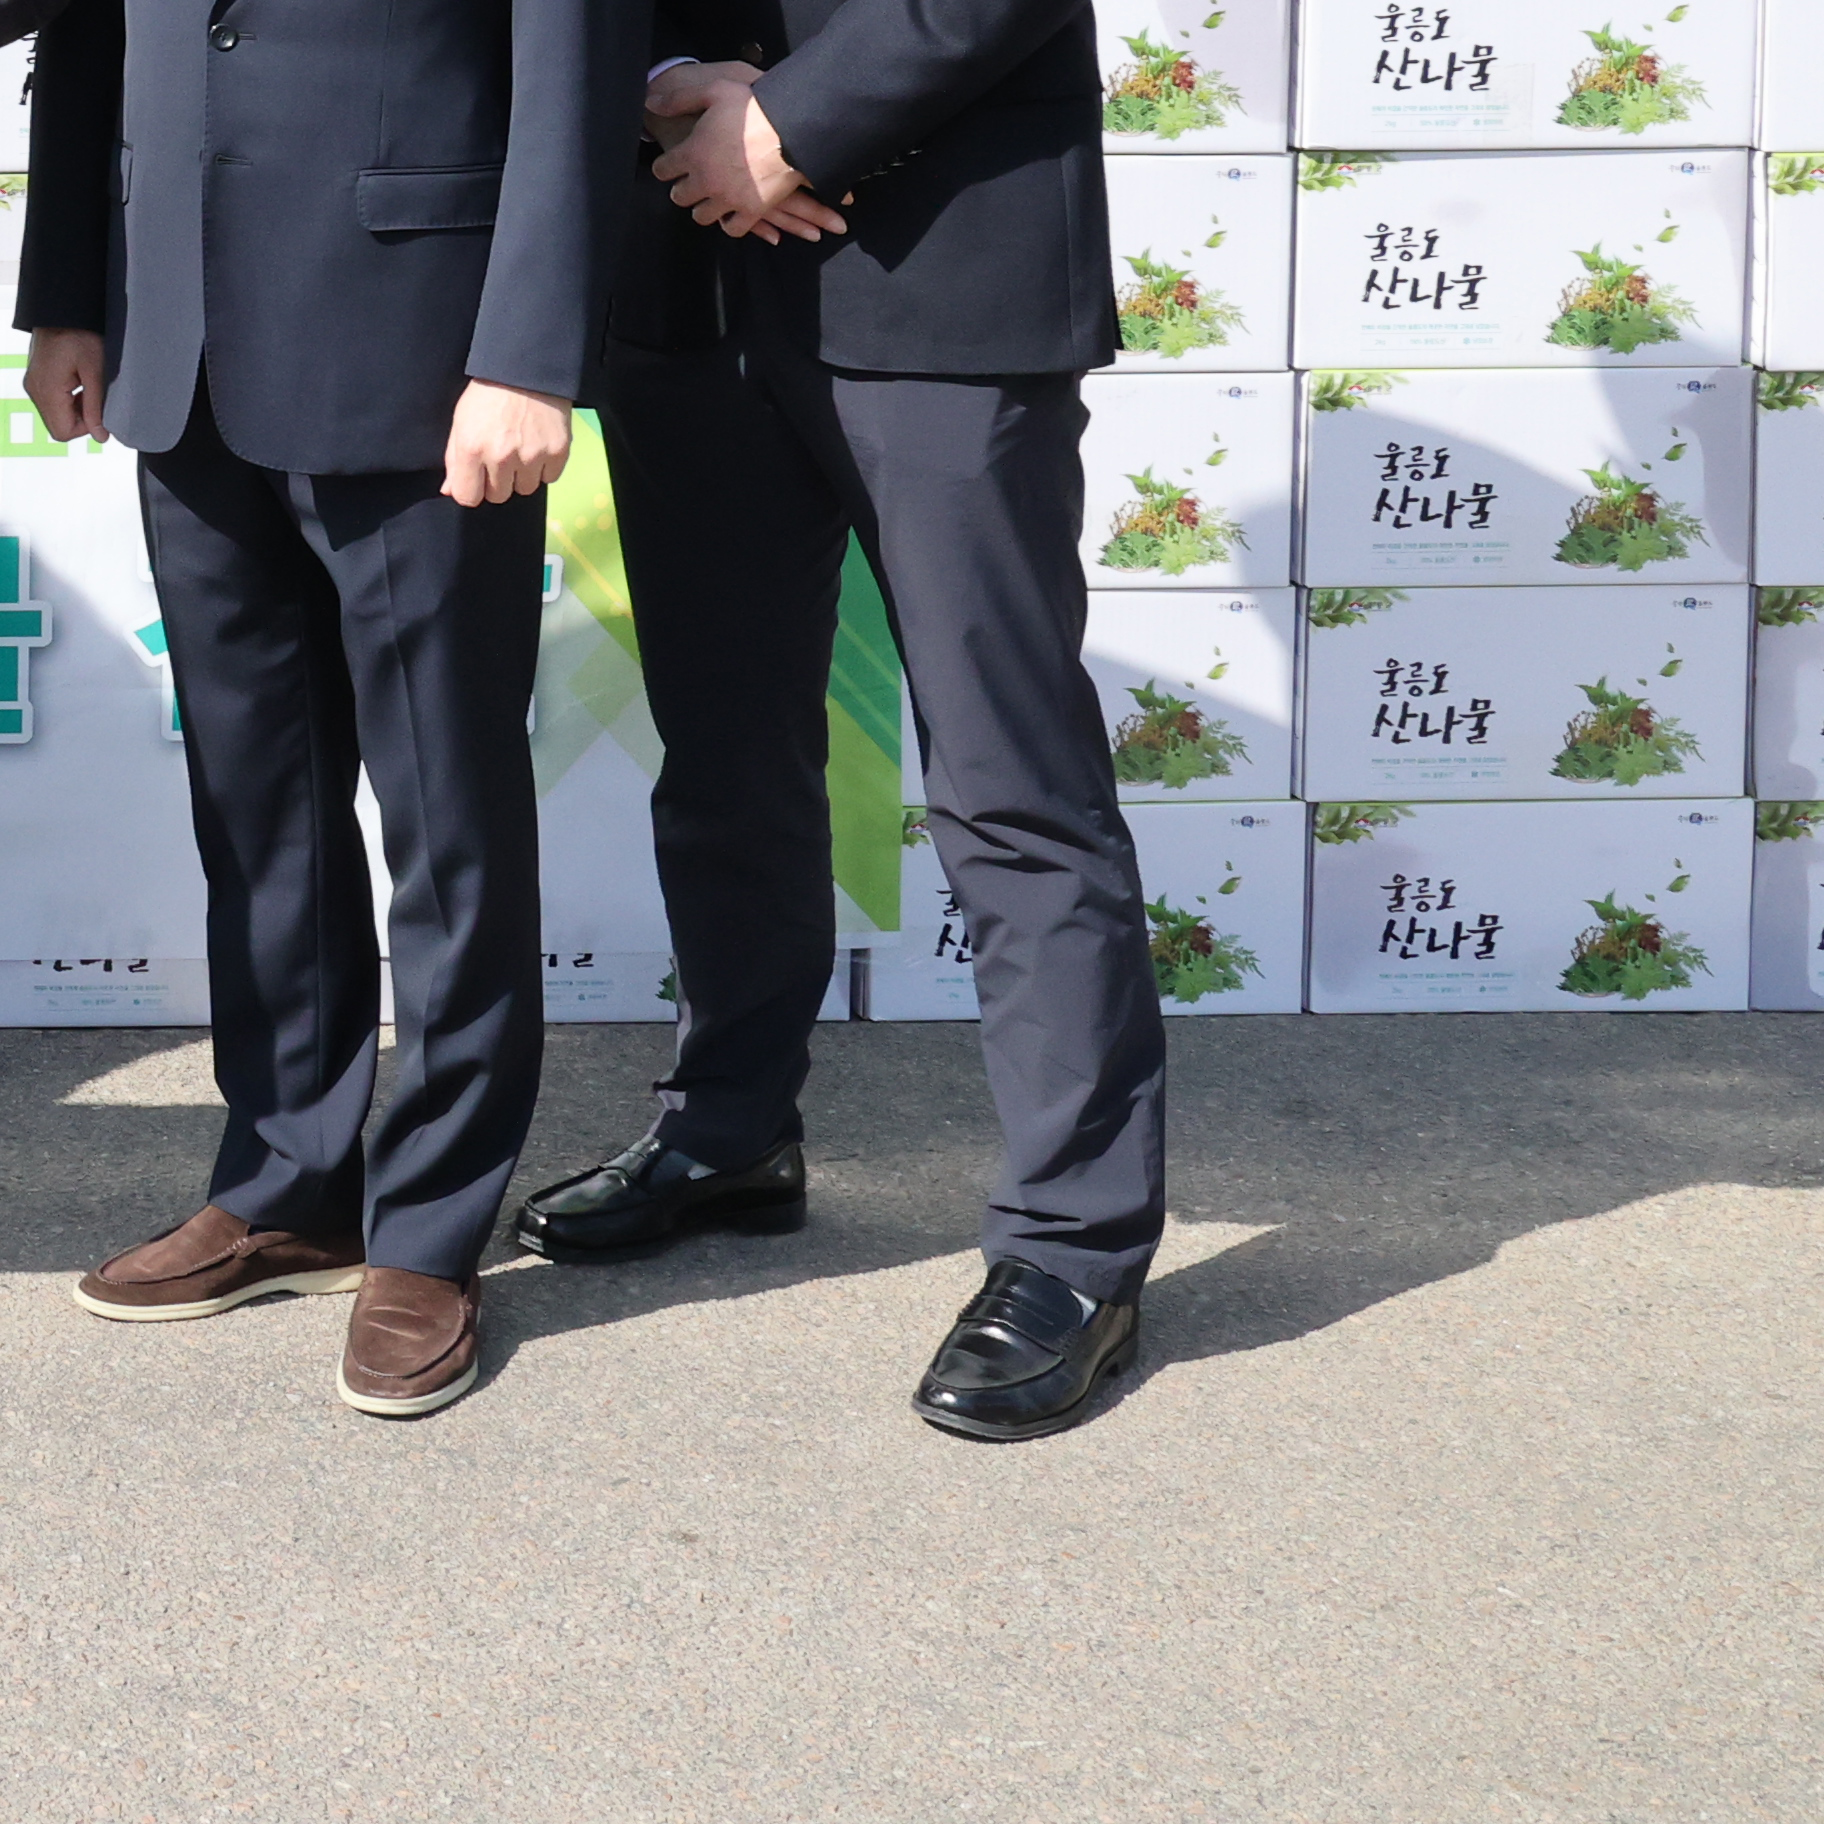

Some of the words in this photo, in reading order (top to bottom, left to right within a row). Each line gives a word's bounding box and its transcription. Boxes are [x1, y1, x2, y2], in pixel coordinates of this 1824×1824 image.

[1375, 4, 1450, 42] 울릉도
[1374, 45, 1497, 91] 산나물
[1365, 223, 1439, 261] 울릉도
[1363, 265, 1486, 309] 산나물
[1373, 442, 1451, 482] 울릉도
[1372, 483, 1498, 529] 산나물
[1373, 658, 1450, 697] 울릉도
[1372, 698, 1496, 744] 산나물
[1380, 874, 1456, 913] 울릉도
[1378, 914, 1504, 960] 산나물
